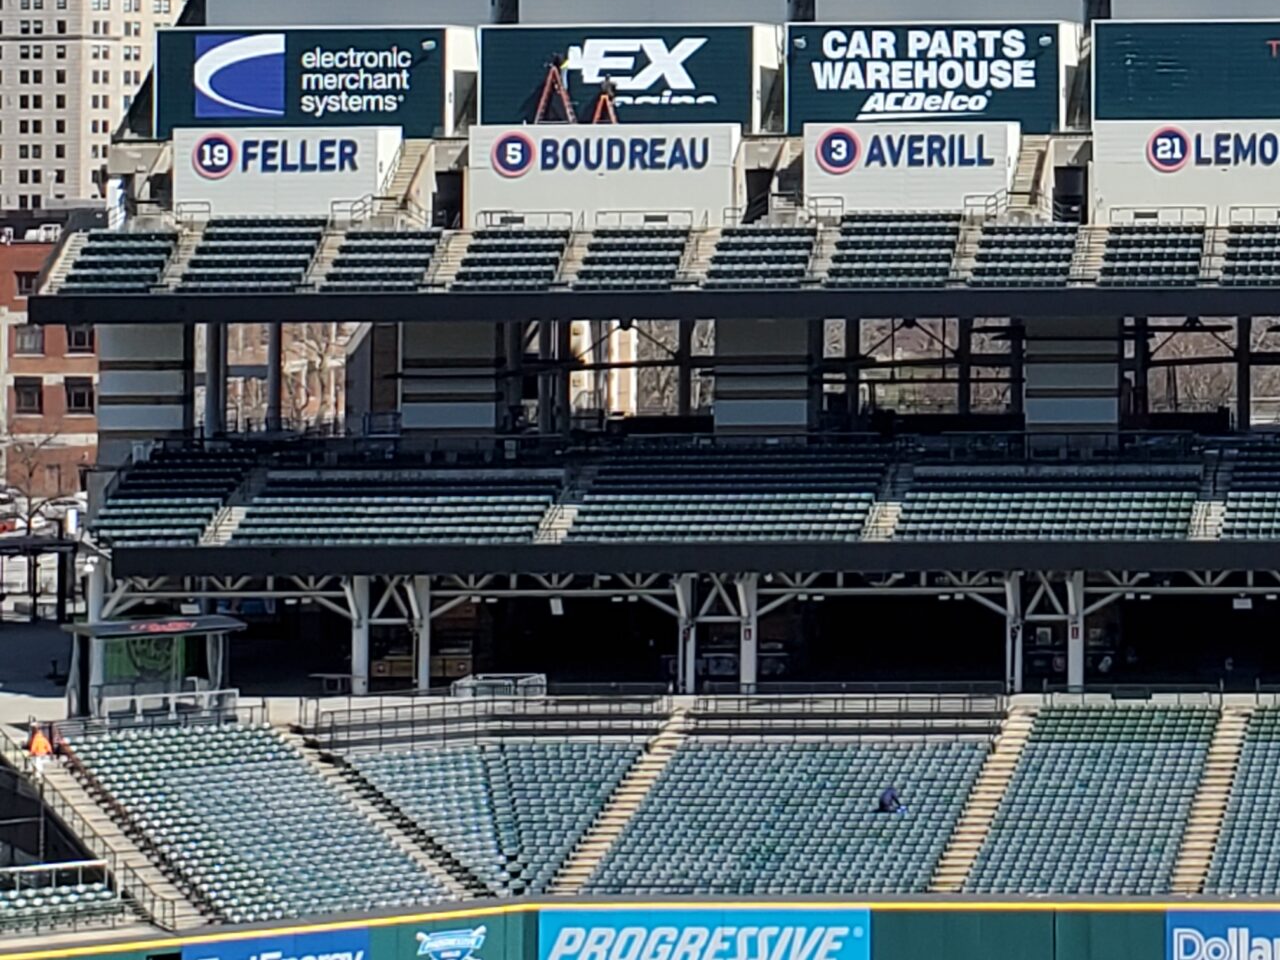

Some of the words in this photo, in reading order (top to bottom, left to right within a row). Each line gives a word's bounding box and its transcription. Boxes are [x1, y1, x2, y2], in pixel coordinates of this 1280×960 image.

[301, 47, 411, 68] electronic
[822, 30, 896, 59] CAR
[907, 29, 1026, 59] PARTS
[301, 69, 409, 90] merchant
[811, 59, 1036, 90] WAREHOUSE
[301, 91, 398, 117] systems
[861, 91, 988, 112] ACDelco
[201, 143, 228, 167] 19
[241, 139, 359, 173] FELLER
[505, 142, 523, 165] 5
[540, 137, 709, 172] BOUDREAU
[830, 139, 848, 162] 3
[864, 133, 995, 168] AVERILL
[1156, 137, 1183, 159] 21
[548, 926, 850, 960] PROGRESSIVE
